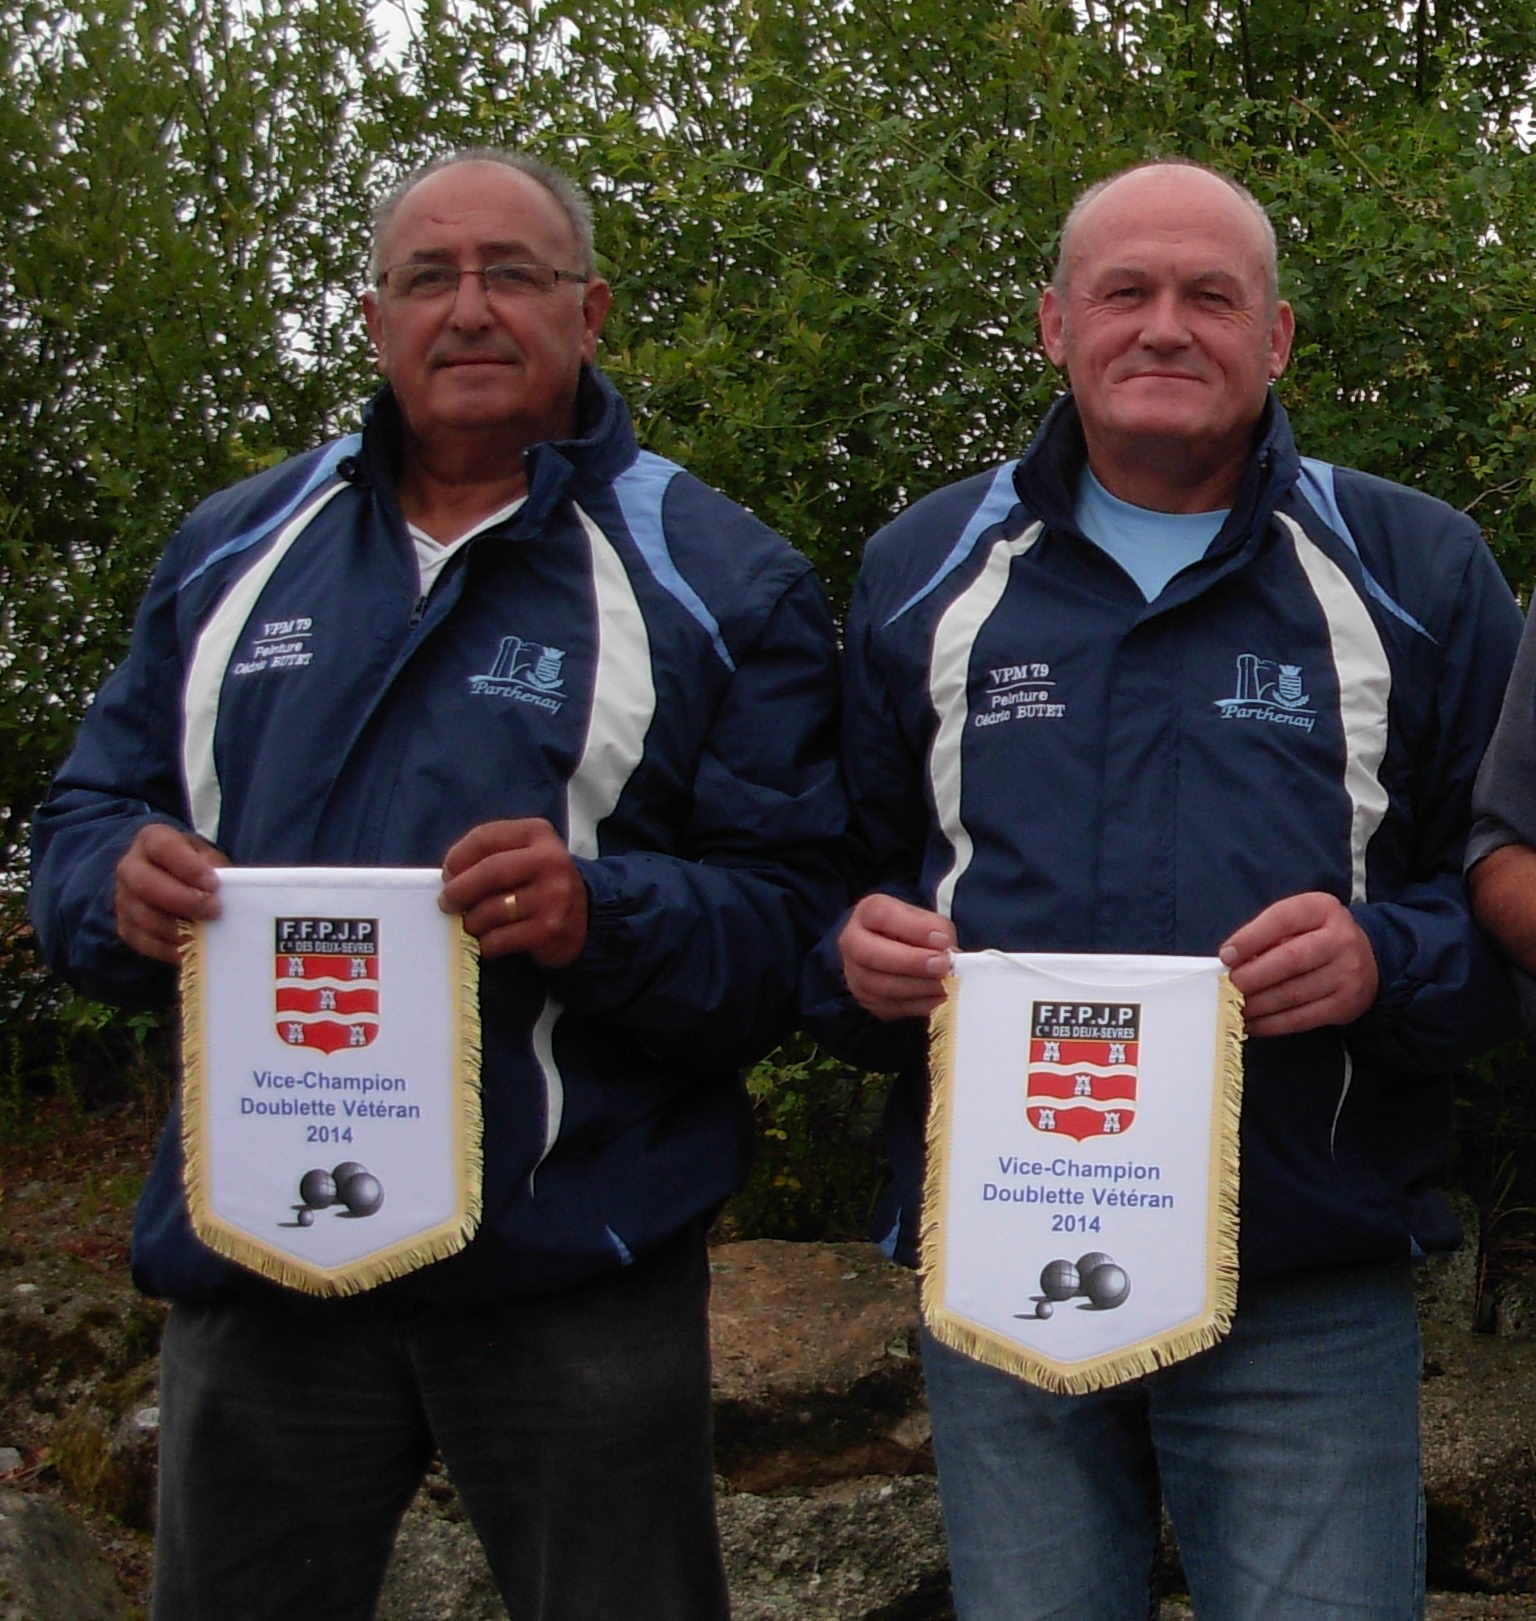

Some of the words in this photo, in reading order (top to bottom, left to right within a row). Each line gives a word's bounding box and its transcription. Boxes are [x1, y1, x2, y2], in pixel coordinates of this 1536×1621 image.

[296, 617, 313, 631] 79
[989, 665, 1028, 684] VPM
[1030, 663, 1050, 677] 79
[470, 681, 563, 715] Parthenay
[991, 690, 1049, 709] Peinture
[1016, 703, 1066, 719] BUTET
[1220, 704, 1316, 733] Parthenay
[1052, 1026, 1071, 1038] DES
[1072, 1026, 1135, 1040] DEUX-SEVRES
[253, 1071, 406, 1094] Vice-Champion
[240, 1097, 337, 1117] Doublette
[342, 1099, 421, 1119] Vétéran
[306, 1125, 354, 1144] 2014
[998, 1156, 1161, 1183] Vice-Champion
[982, 1183, 1085, 1206] Doublette
[1091, 1187, 1175, 1209] Vétéran
[1051, 1214, 1101, 1234] 2014
